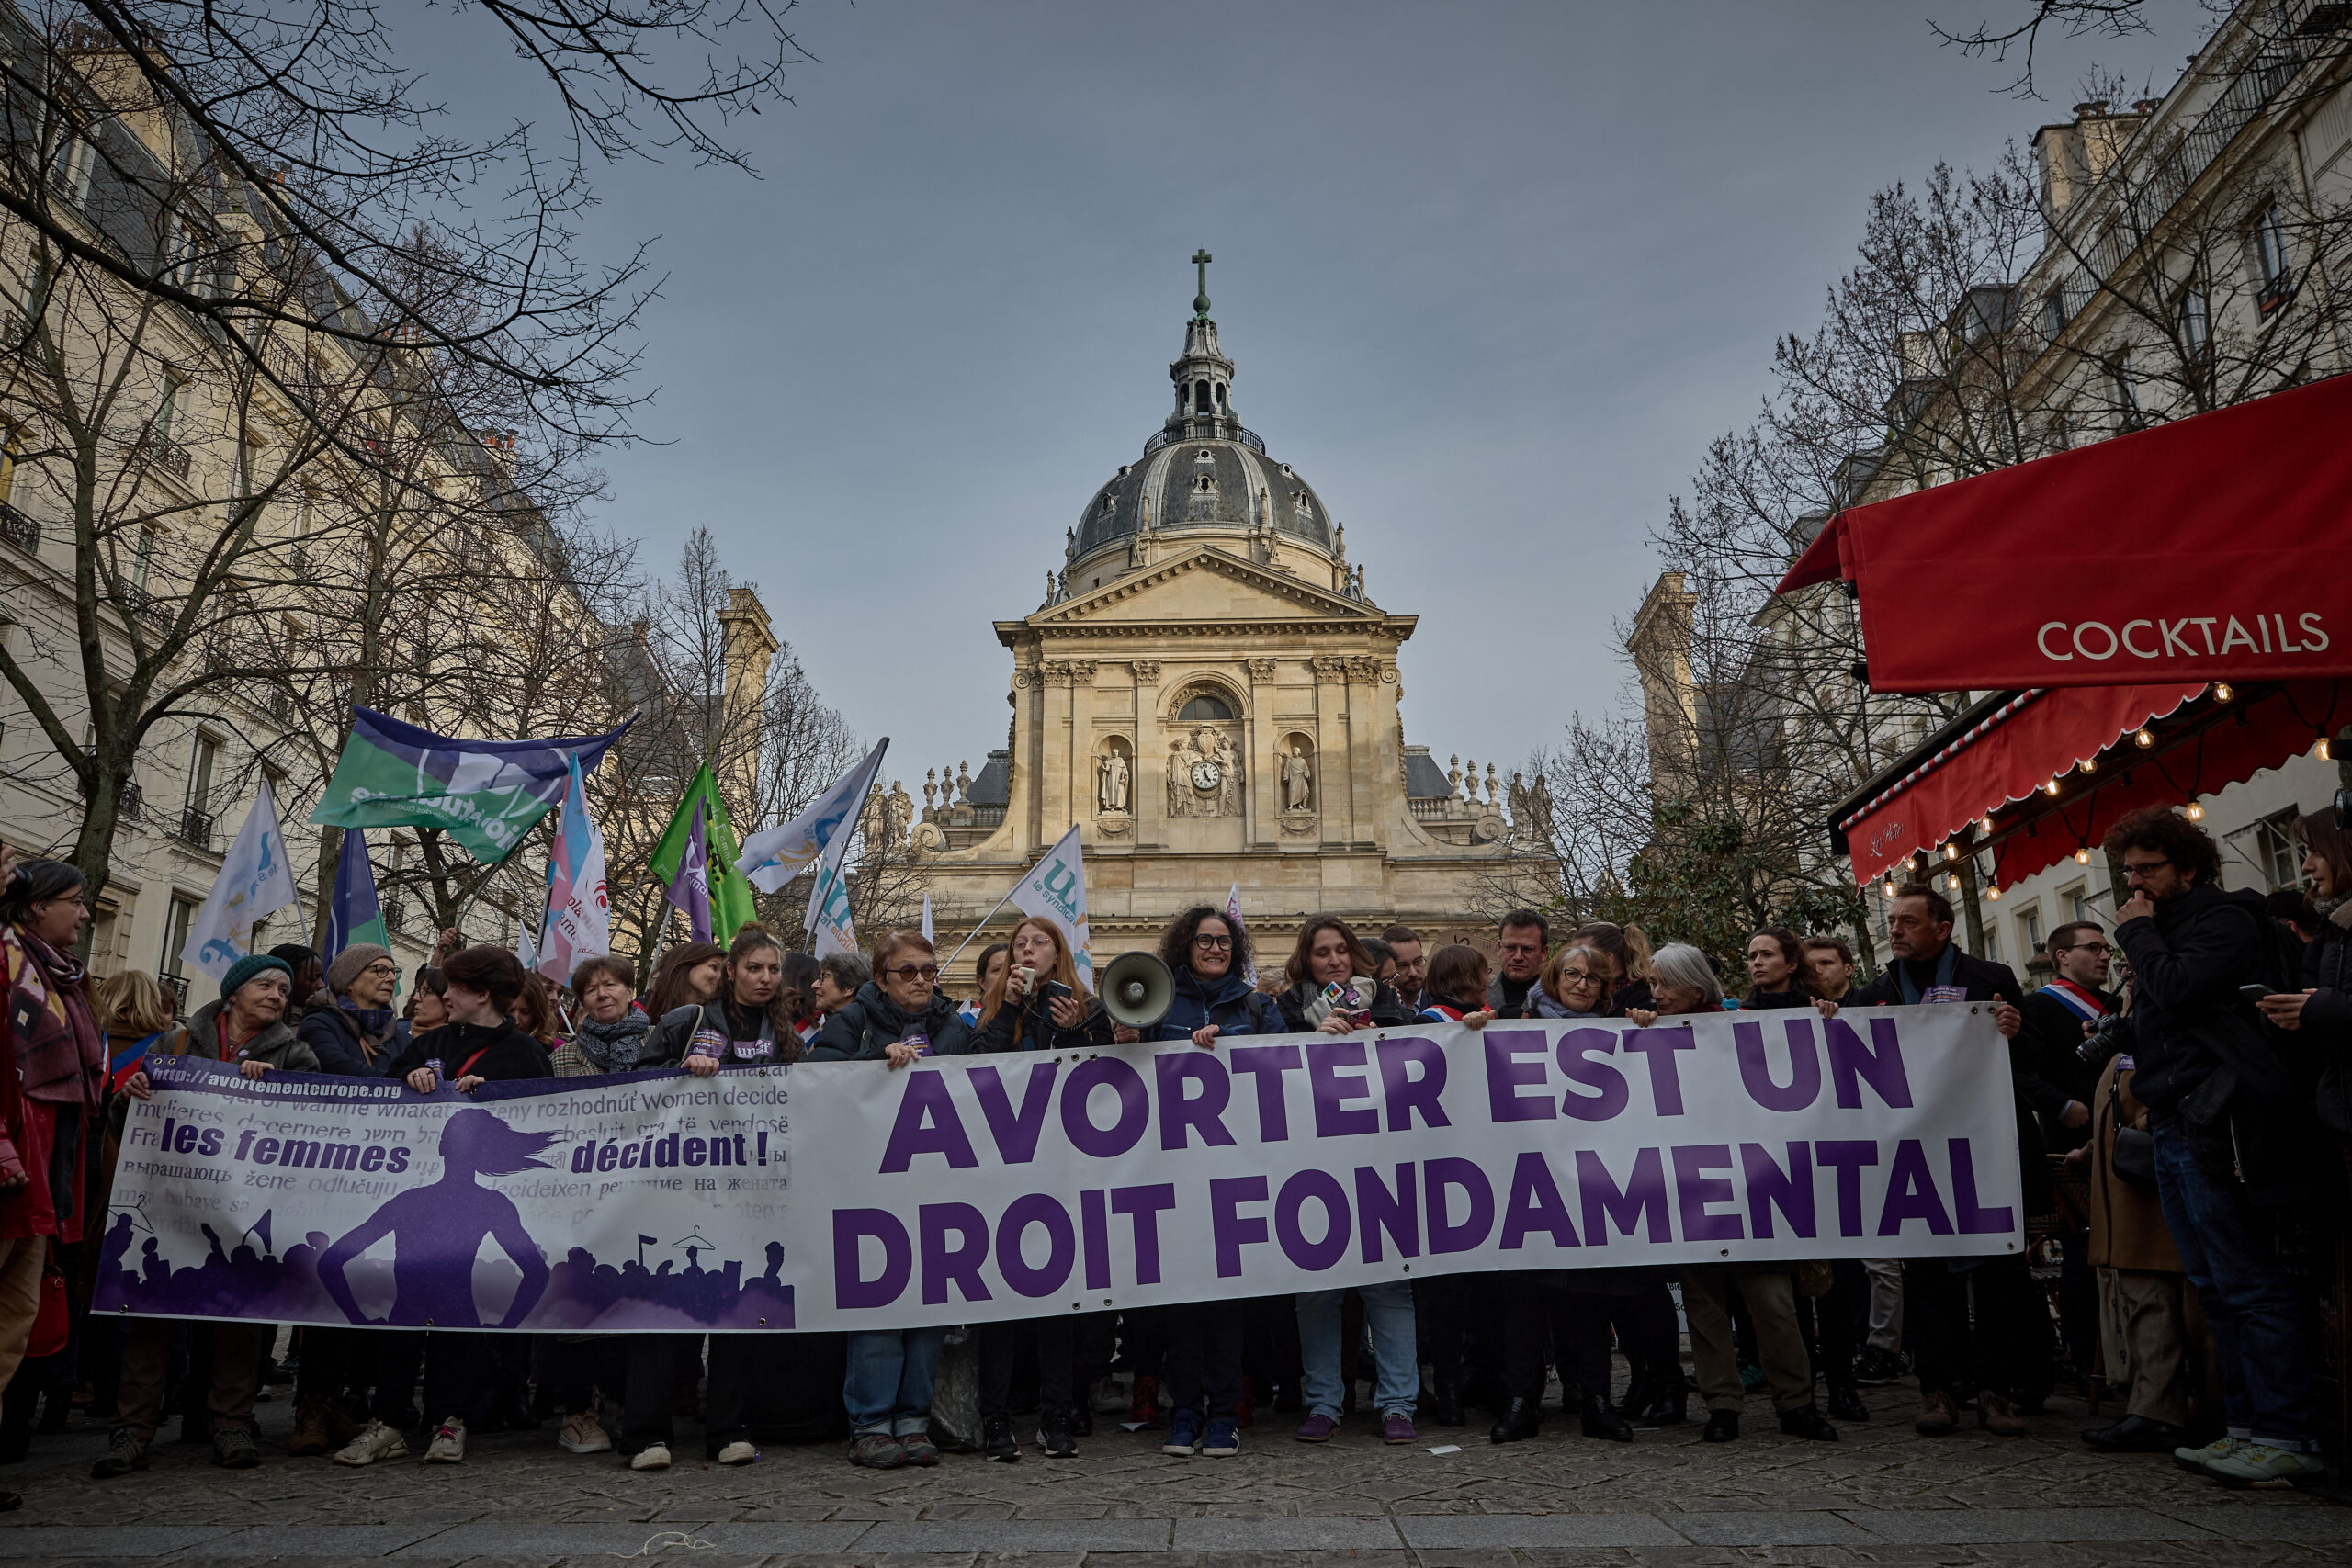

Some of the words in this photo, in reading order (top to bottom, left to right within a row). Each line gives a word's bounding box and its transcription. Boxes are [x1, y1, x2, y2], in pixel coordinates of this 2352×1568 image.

[2037, 612, 2329, 661] COCKTAILS
[1033, 879, 1043, 893] le
[152, 1067, 401, 1099] http://avortementeurope.org
[878, 1036, 1452, 1174] AVORTER
[1483, 1026, 1696, 1123] EST
[1733, 1018, 1913, 1112] UN
[537, 1090, 638, 1118] rozhodnúť
[641, 1090, 718, 1111] Women
[723, 1085, 789, 1106] decide
[160, 1117, 225, 1156] les
[234, 1129, 411, 1173] femmes
[571, 1132, 748, 1173] décident
[244, 1169, 297, 1190] žene
[694, 1178, 717, 1190] на
[832, 1182, 1176, 1310] DROIT
[1209, 1138, 2015, 1278] FONDAMENTAL
